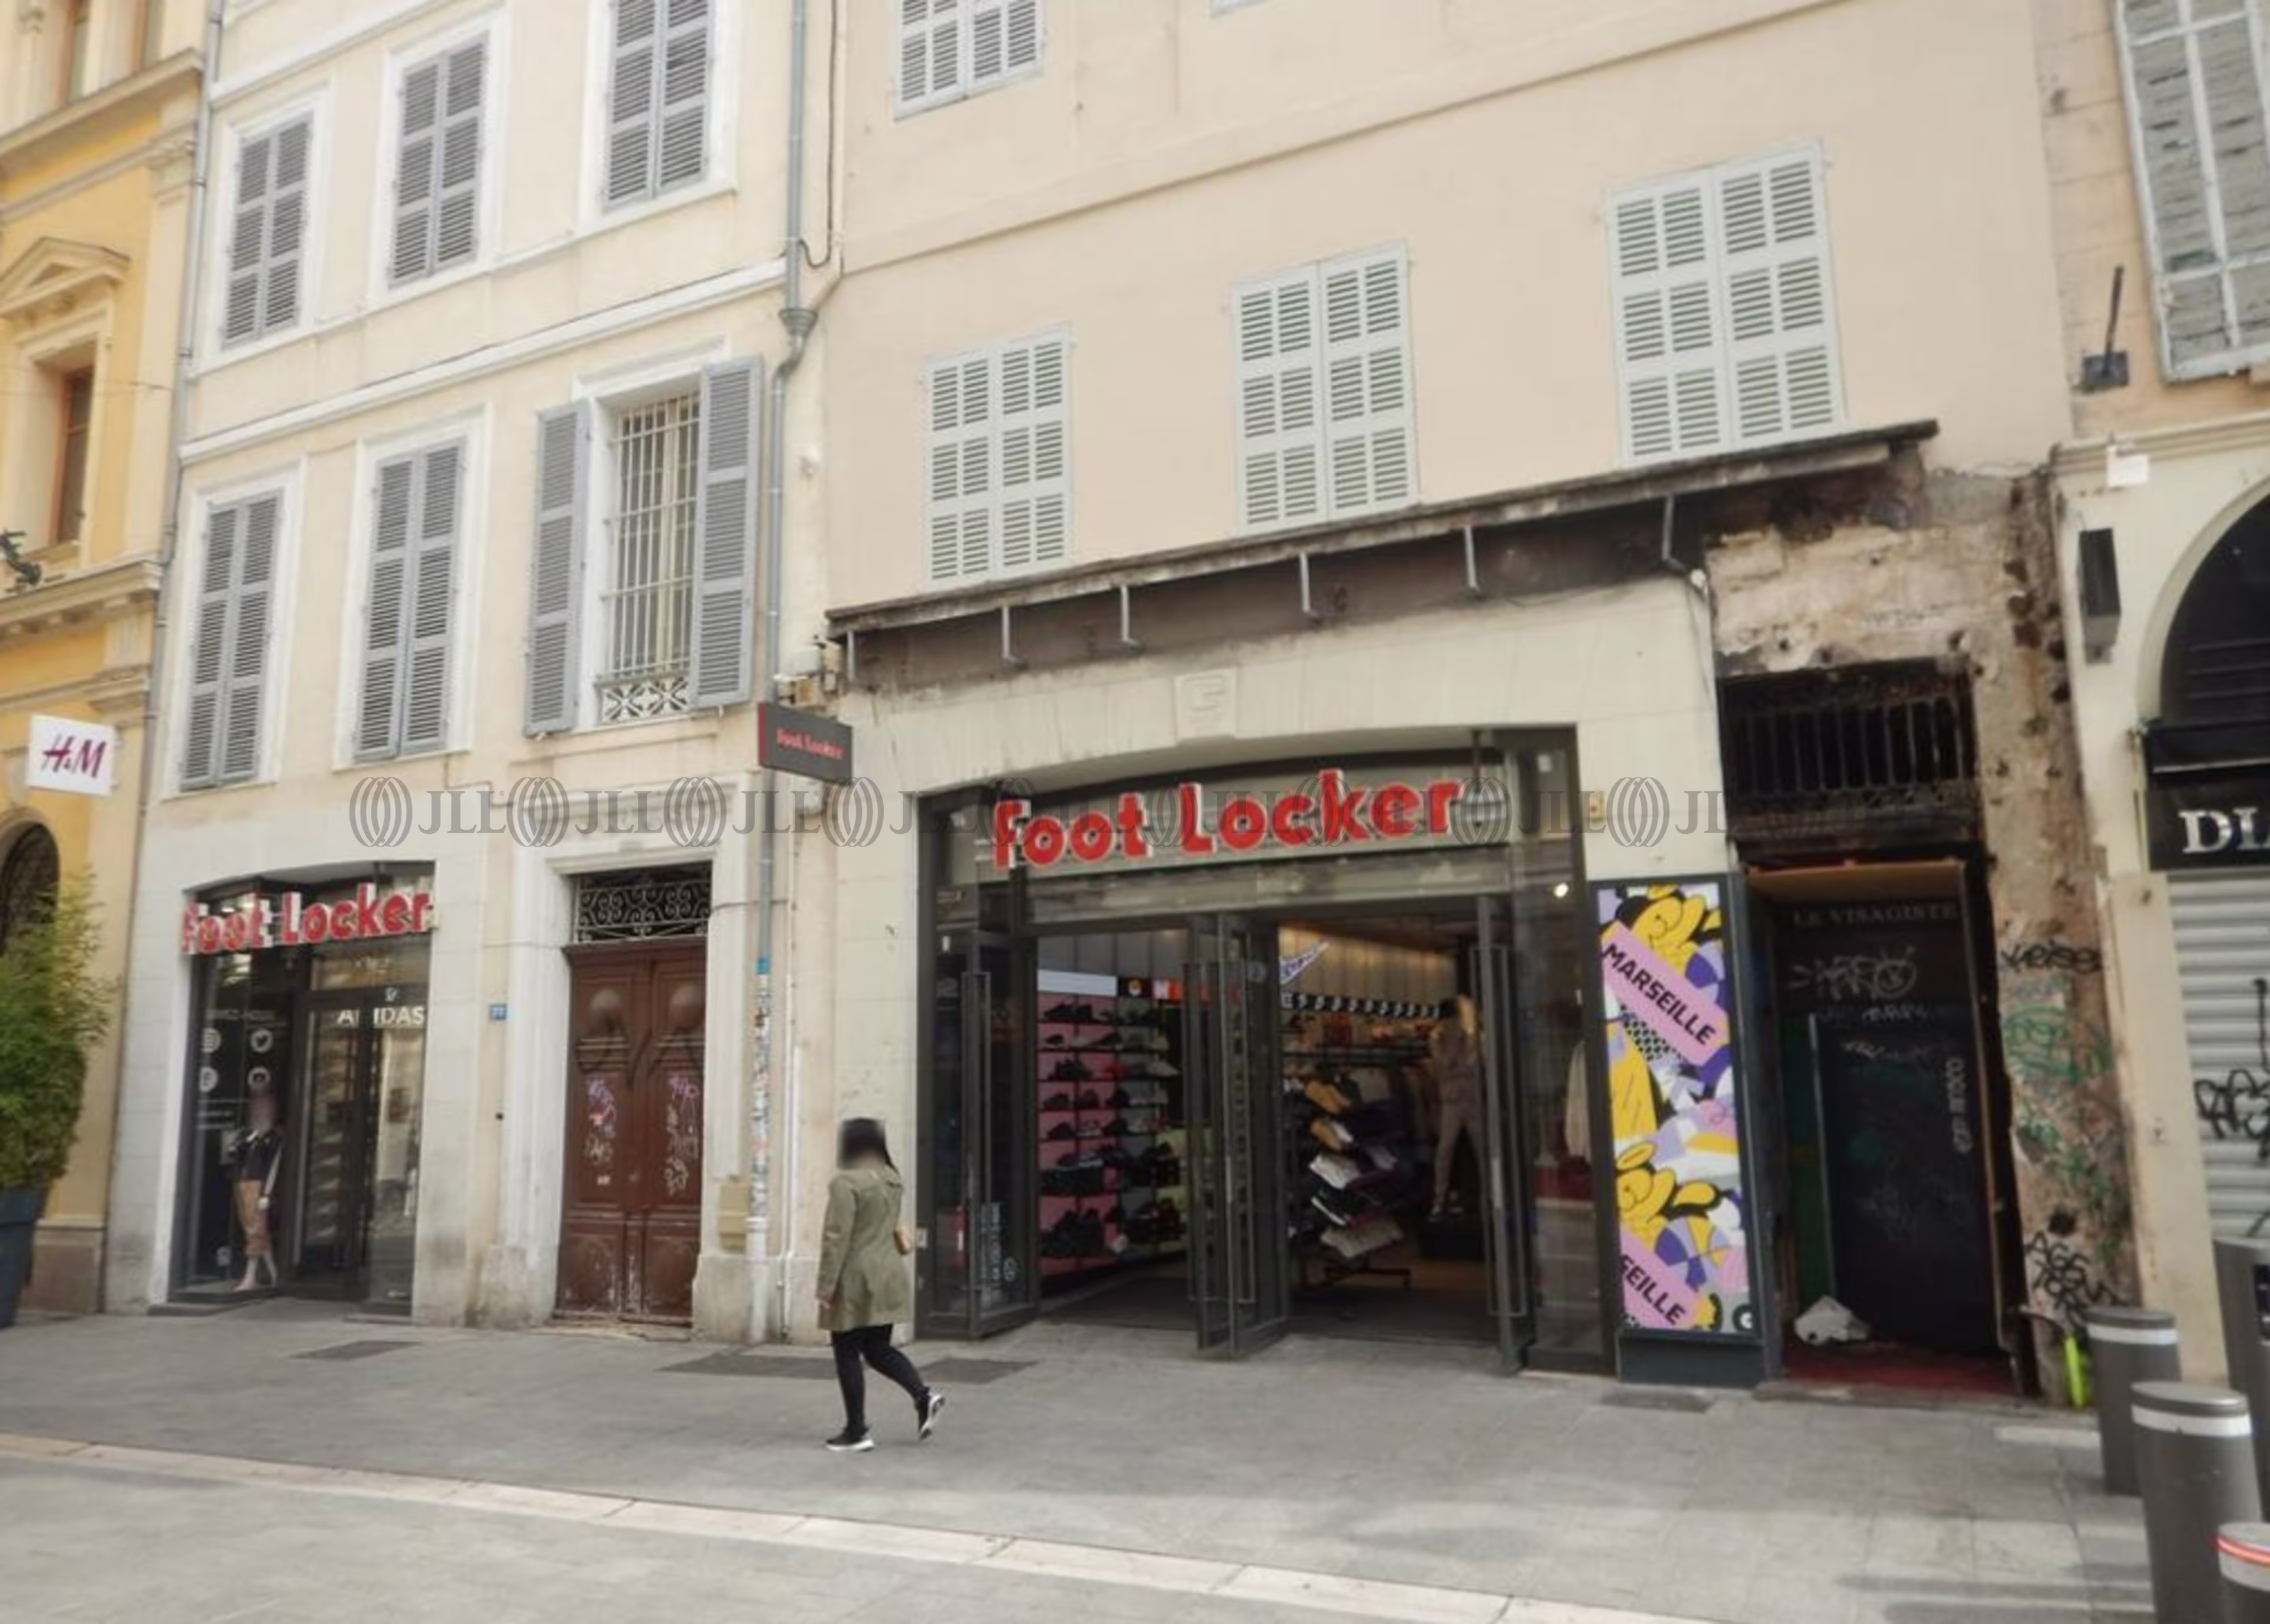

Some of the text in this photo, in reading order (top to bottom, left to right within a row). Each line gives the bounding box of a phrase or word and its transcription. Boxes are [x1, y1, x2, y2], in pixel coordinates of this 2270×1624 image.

[41, 733, 107, 778] H&M
[994, 791, 1153, 869] Foot
[1179, 768, 1465, 855] Locker
[181, 883, 433, 955] Foot Locker
[1602, 943, 1716, 1045] MARSEILLE
